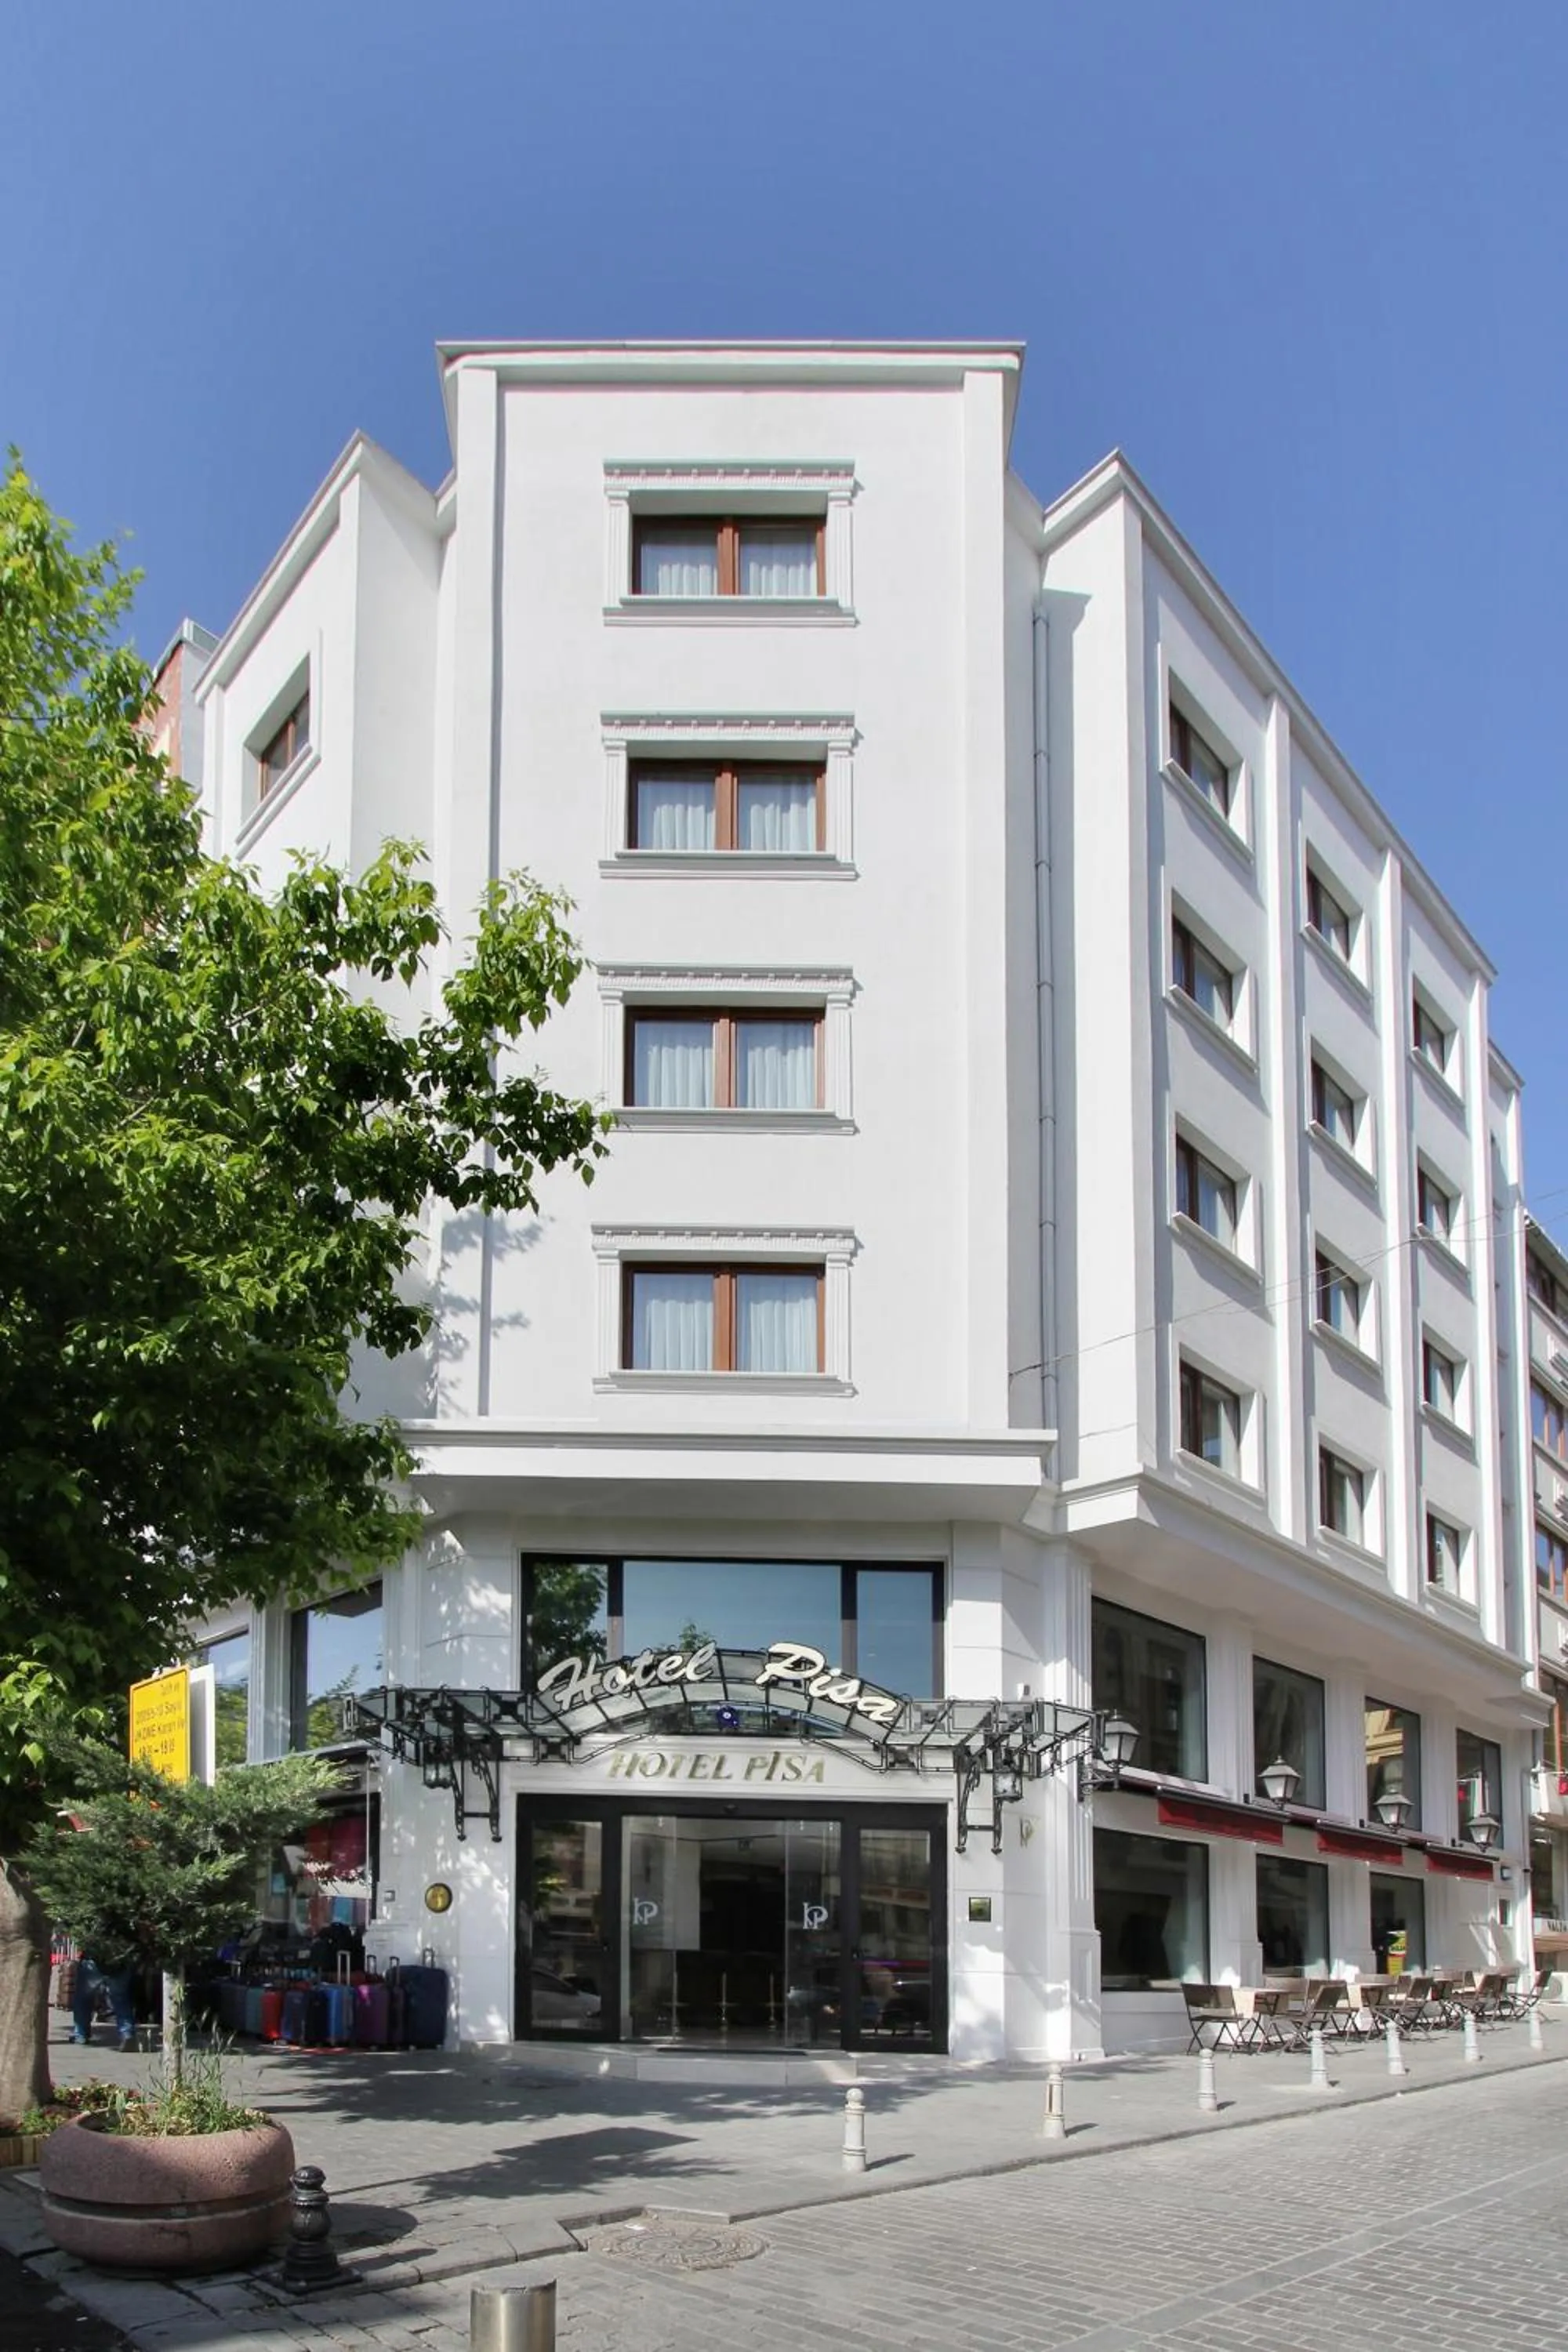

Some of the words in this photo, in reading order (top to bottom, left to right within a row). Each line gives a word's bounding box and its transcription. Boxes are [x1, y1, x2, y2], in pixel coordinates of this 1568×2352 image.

[537, 1641, 717, 1712] Hotel
[756, 1642, 898, 1722] Pisa
[608, 1751, 731, 1780] HOTEL
